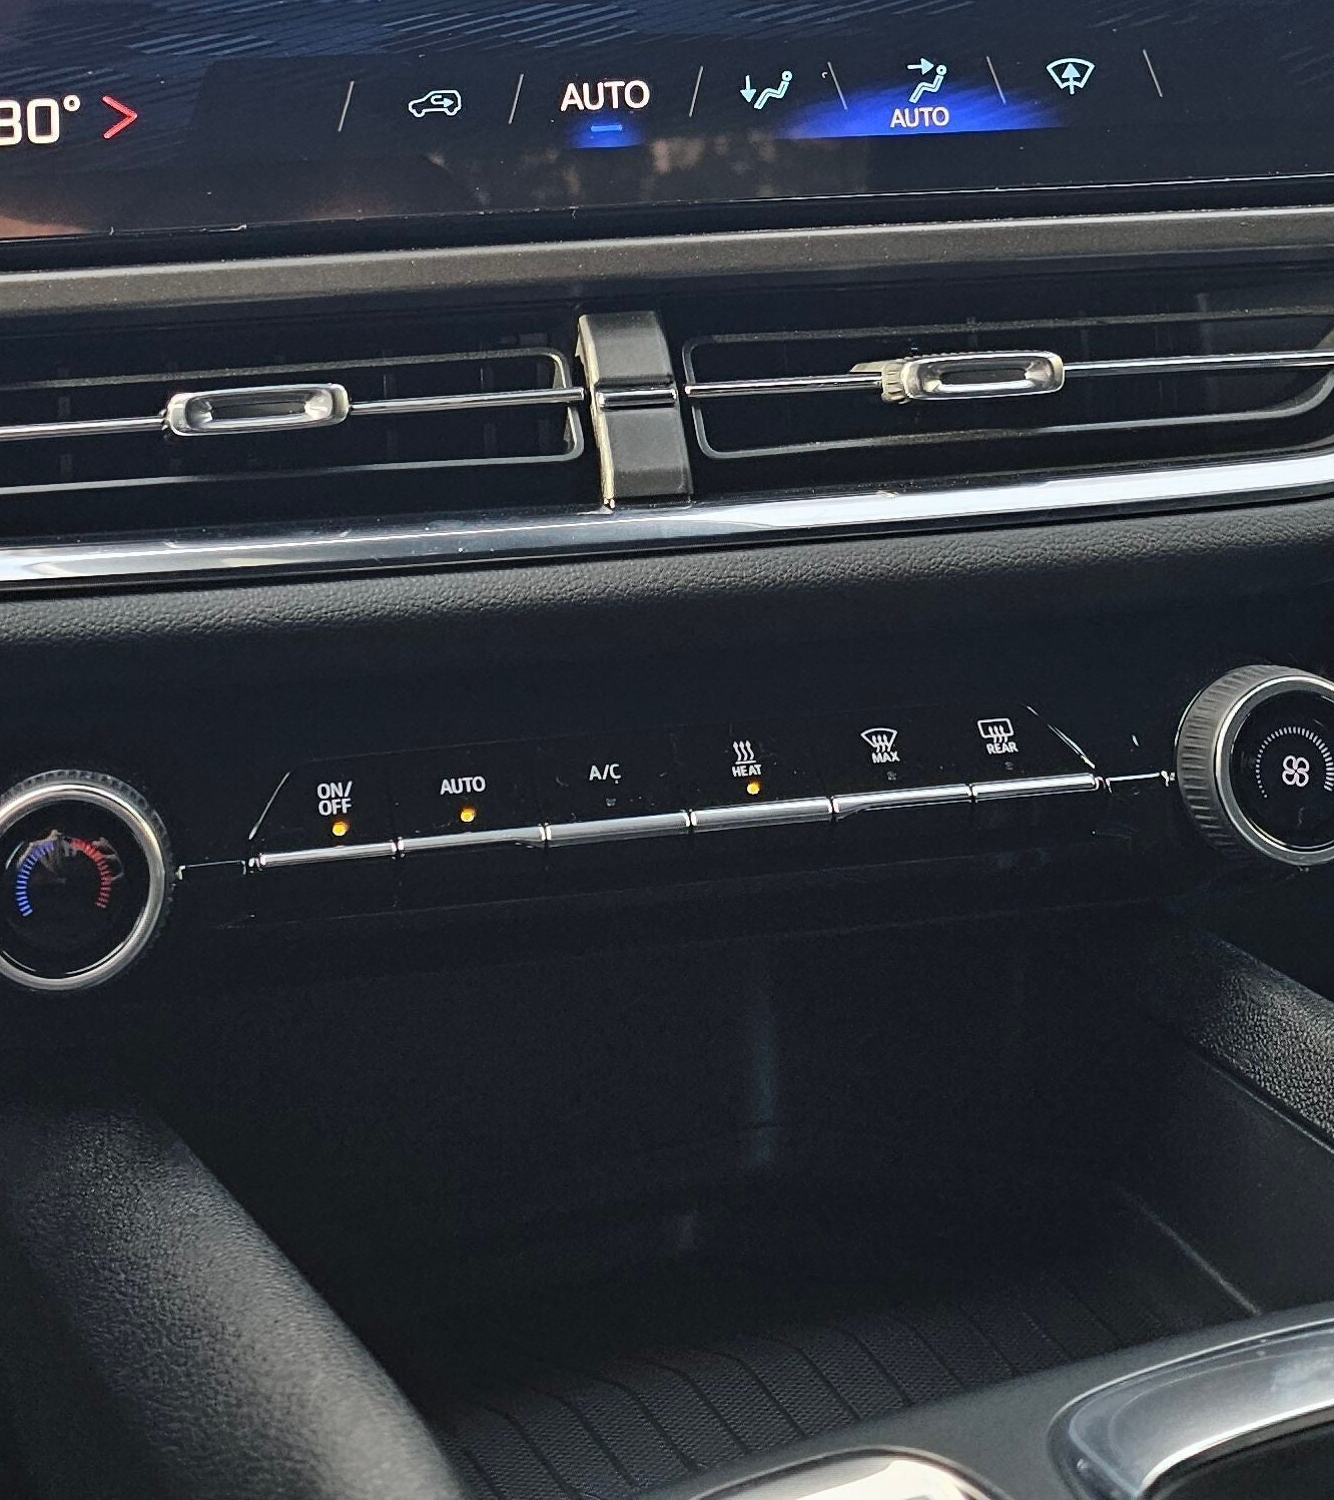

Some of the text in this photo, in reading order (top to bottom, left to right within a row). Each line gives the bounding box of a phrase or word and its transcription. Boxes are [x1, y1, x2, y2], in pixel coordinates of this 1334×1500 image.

[560, 78, 651, 112] AUTO
[889, 105, 950, 129] AUTO
[872, 751, 901, 764] MAX
[986, 741, 1019, 756] REAR
[589, 763, 622, 781] A/C
[732, 764, 762, 778] HEAT
[317, 781, 353, 799] ON/
[440, 776, 486, 795] AUTO
[318, 798, 353, 816] OFF
